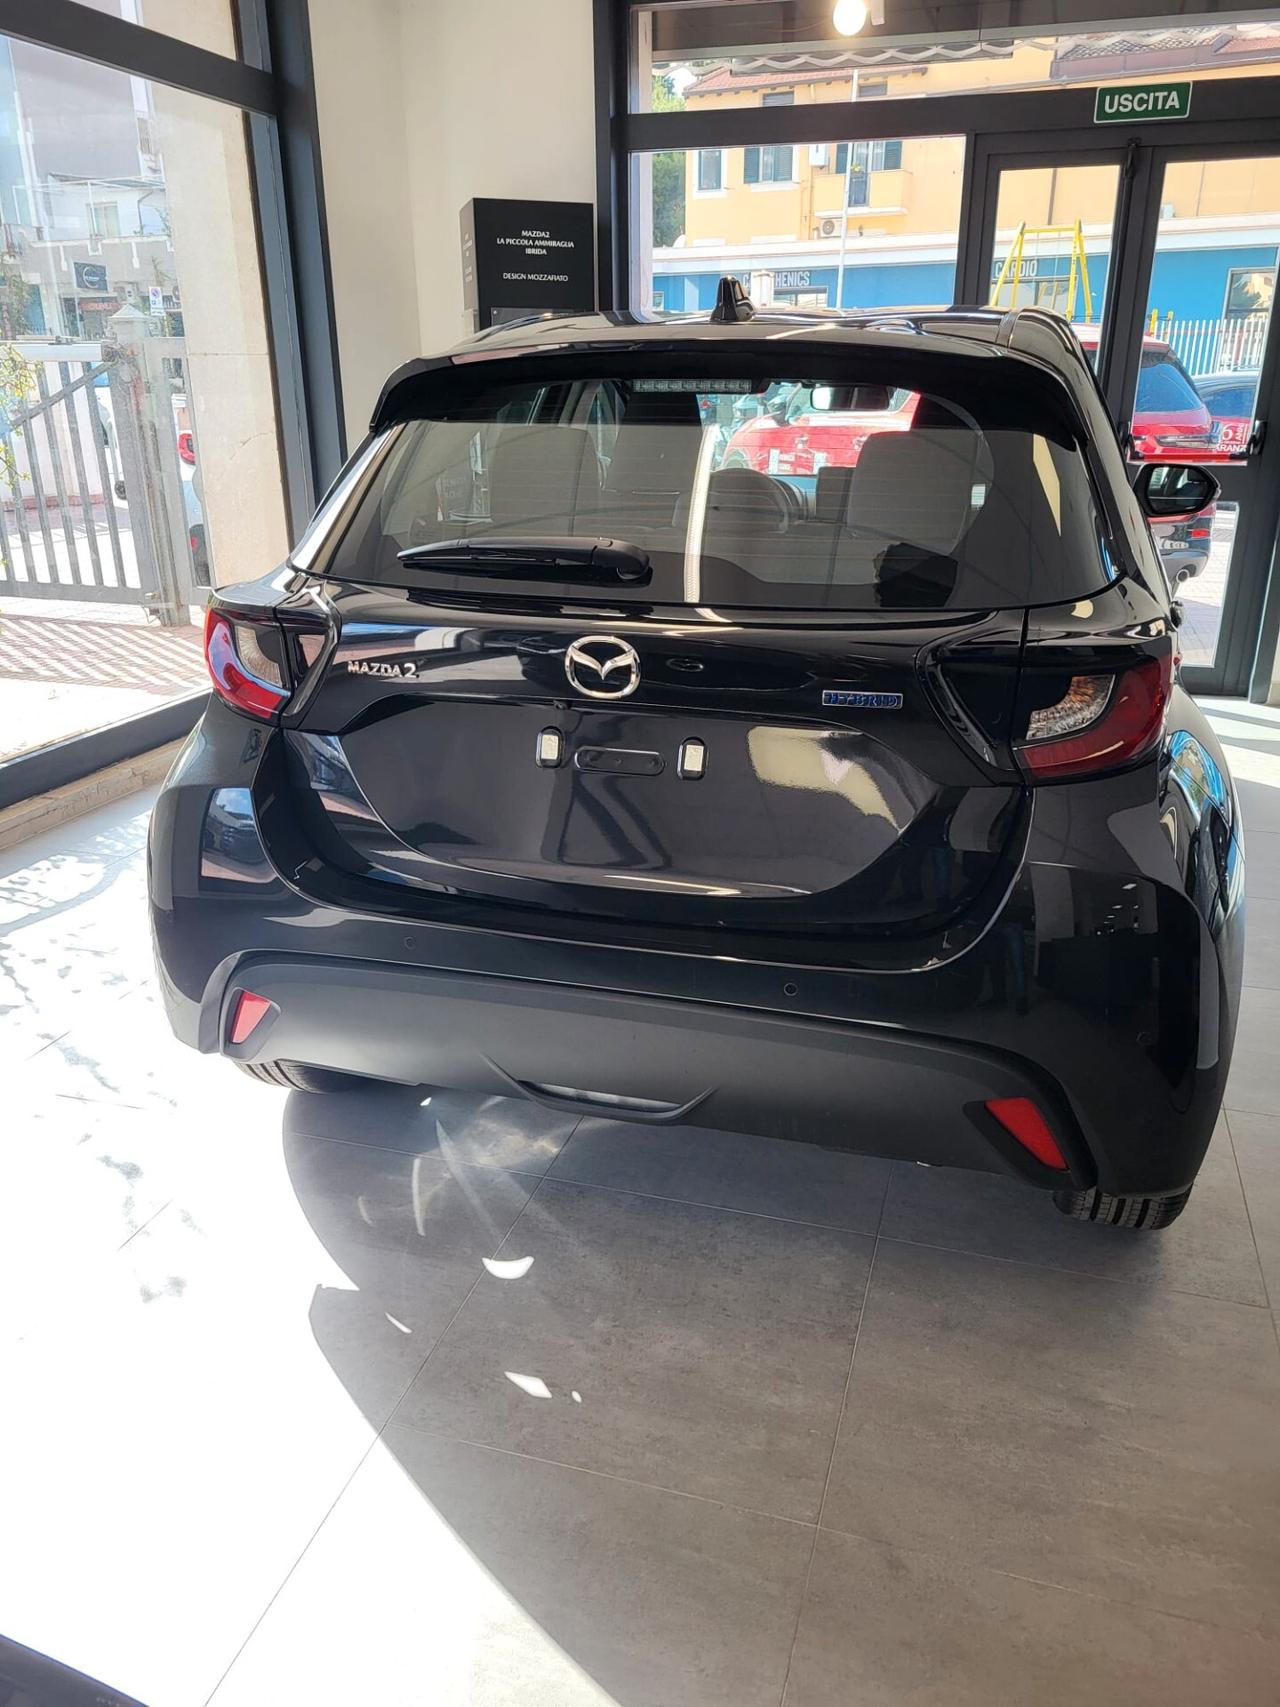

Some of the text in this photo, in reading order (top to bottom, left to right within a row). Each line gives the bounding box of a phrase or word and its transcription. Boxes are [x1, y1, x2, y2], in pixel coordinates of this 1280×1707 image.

[1104, 91, 1180, 114] USCITA
[521, 230, 550, 238] MAZDA2
[505, 238, 533, 246] PICCOLA
[534, 239, 575, 248] AMMIRAGLIA
[525, 247, 547, 255] IBRIDA
[995, 260, 1038, 278] CRDIO
[503, 272, 569, 282] DESIGN MOZZAFIATO
[825, 692, 898, 708] HYBRID
